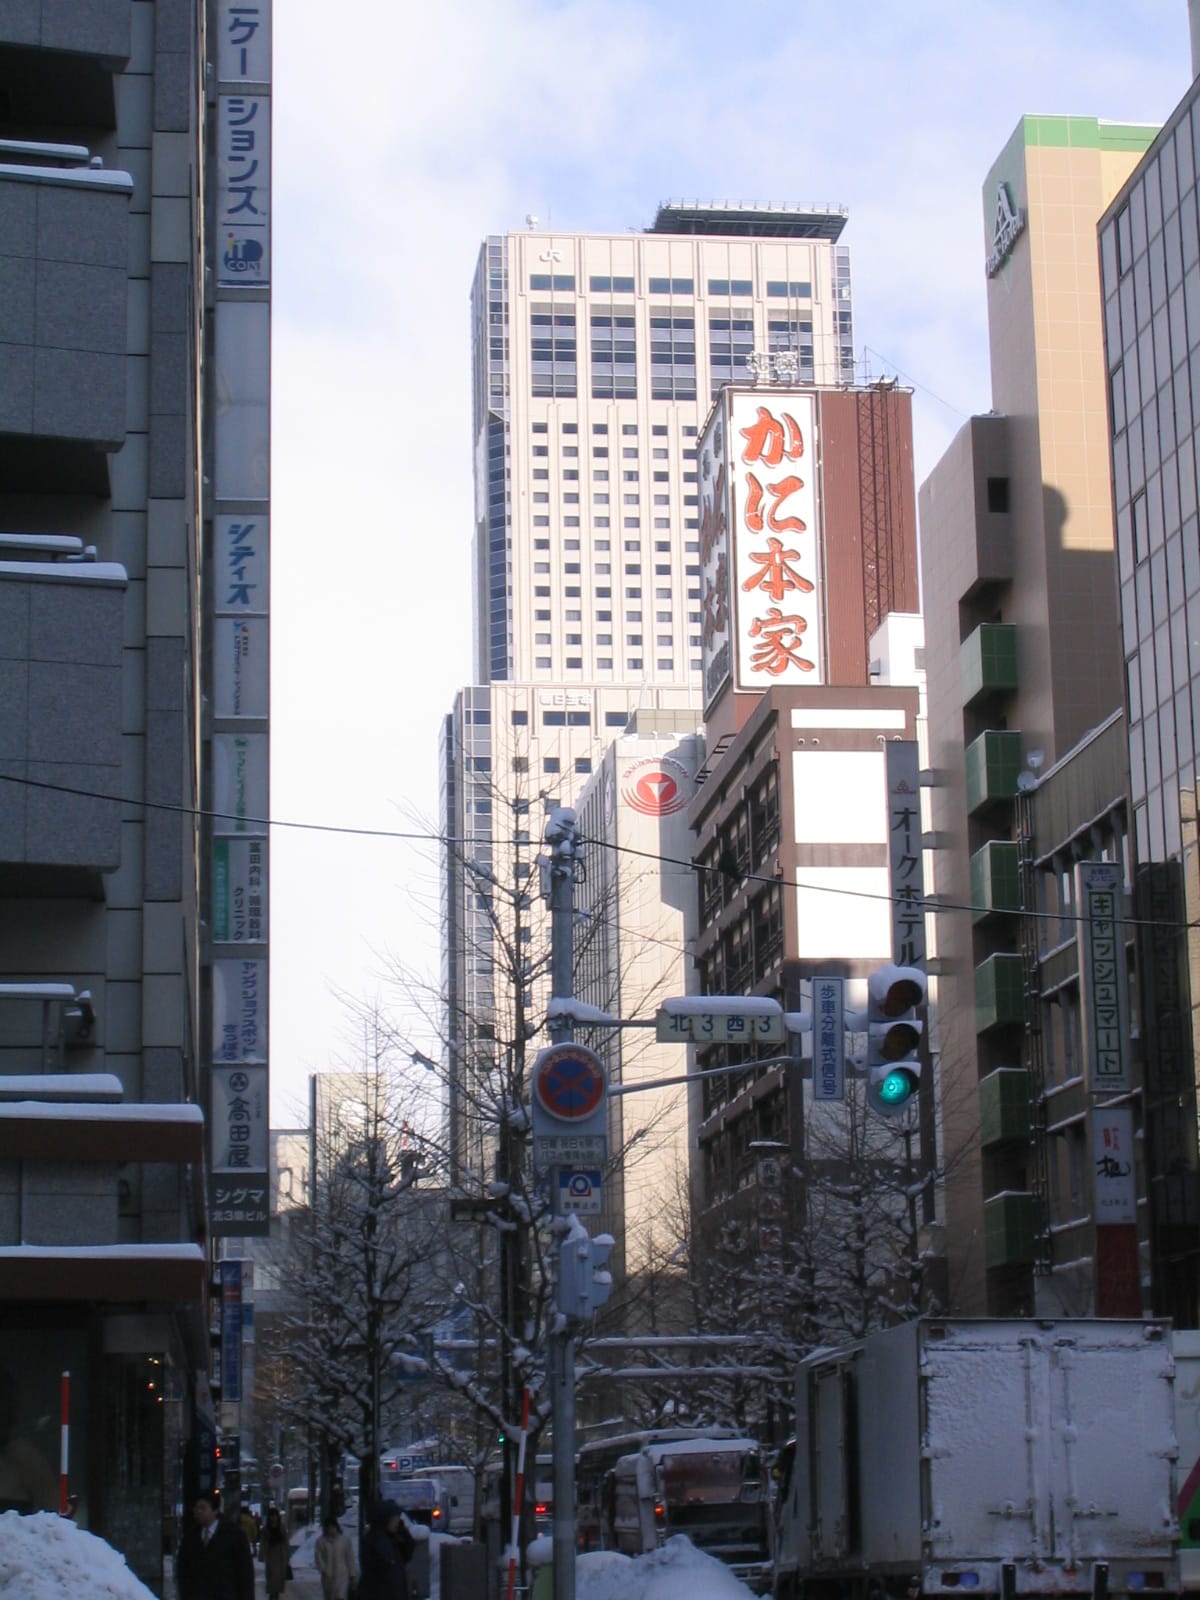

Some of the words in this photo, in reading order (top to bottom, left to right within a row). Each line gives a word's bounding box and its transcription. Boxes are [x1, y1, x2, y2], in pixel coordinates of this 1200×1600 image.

[740, 406, 815, 677] かに本家
[232, 886, 246, 940] クリニック
[892, 806, 922, 967] オークホテル
[820, 983, 838, 1095] 歩車分離式信号
[1094, 895, 1117, 1072] キャッシュマート
[215, 1188, 264, 1204] シグマ
